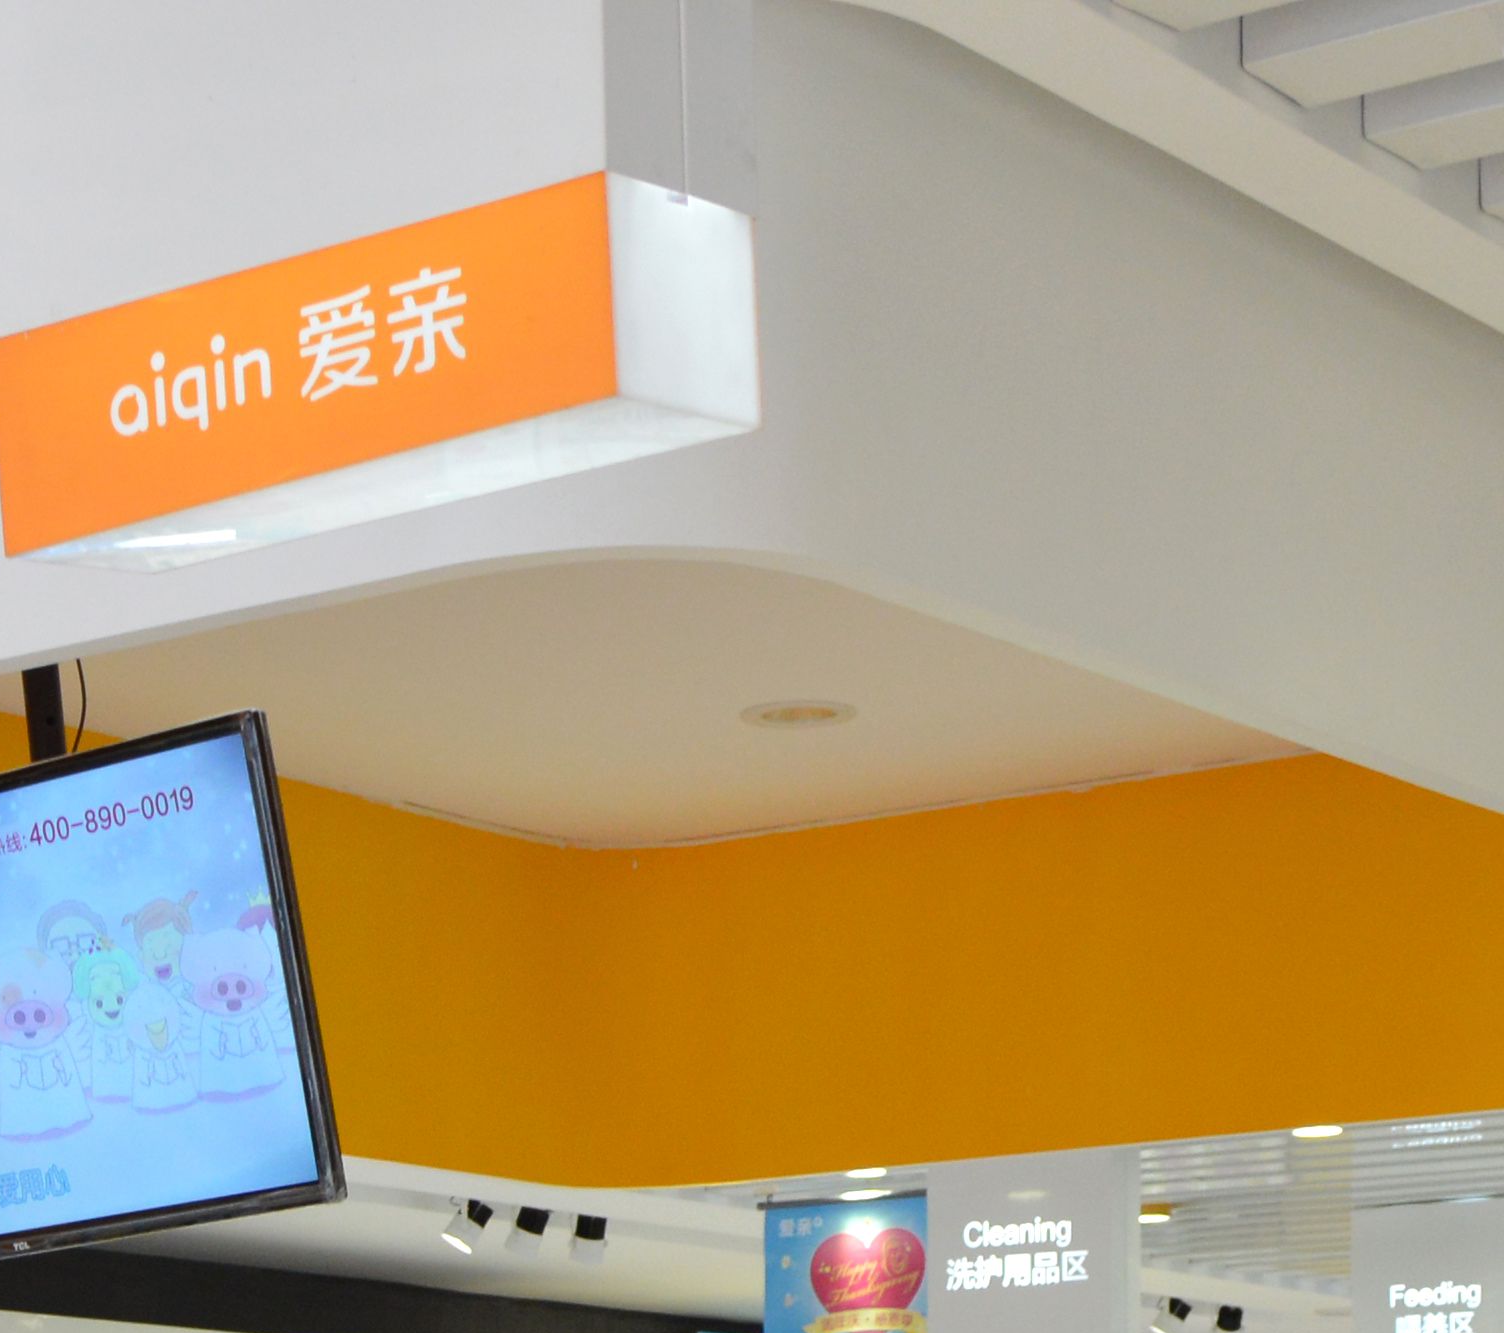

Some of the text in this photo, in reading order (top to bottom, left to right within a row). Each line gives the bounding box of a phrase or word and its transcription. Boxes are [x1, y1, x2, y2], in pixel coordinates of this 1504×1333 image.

[108, 263, 469, 438] aiqin 爱亲
[29, 784, 195, 847] 400-890-0019
[963, 1215, 1072, 1249] Cleaning
[945, 1249, 1089, 1291] 洗护用品区
[1388, 1281, 1483, 1312] Feeding
